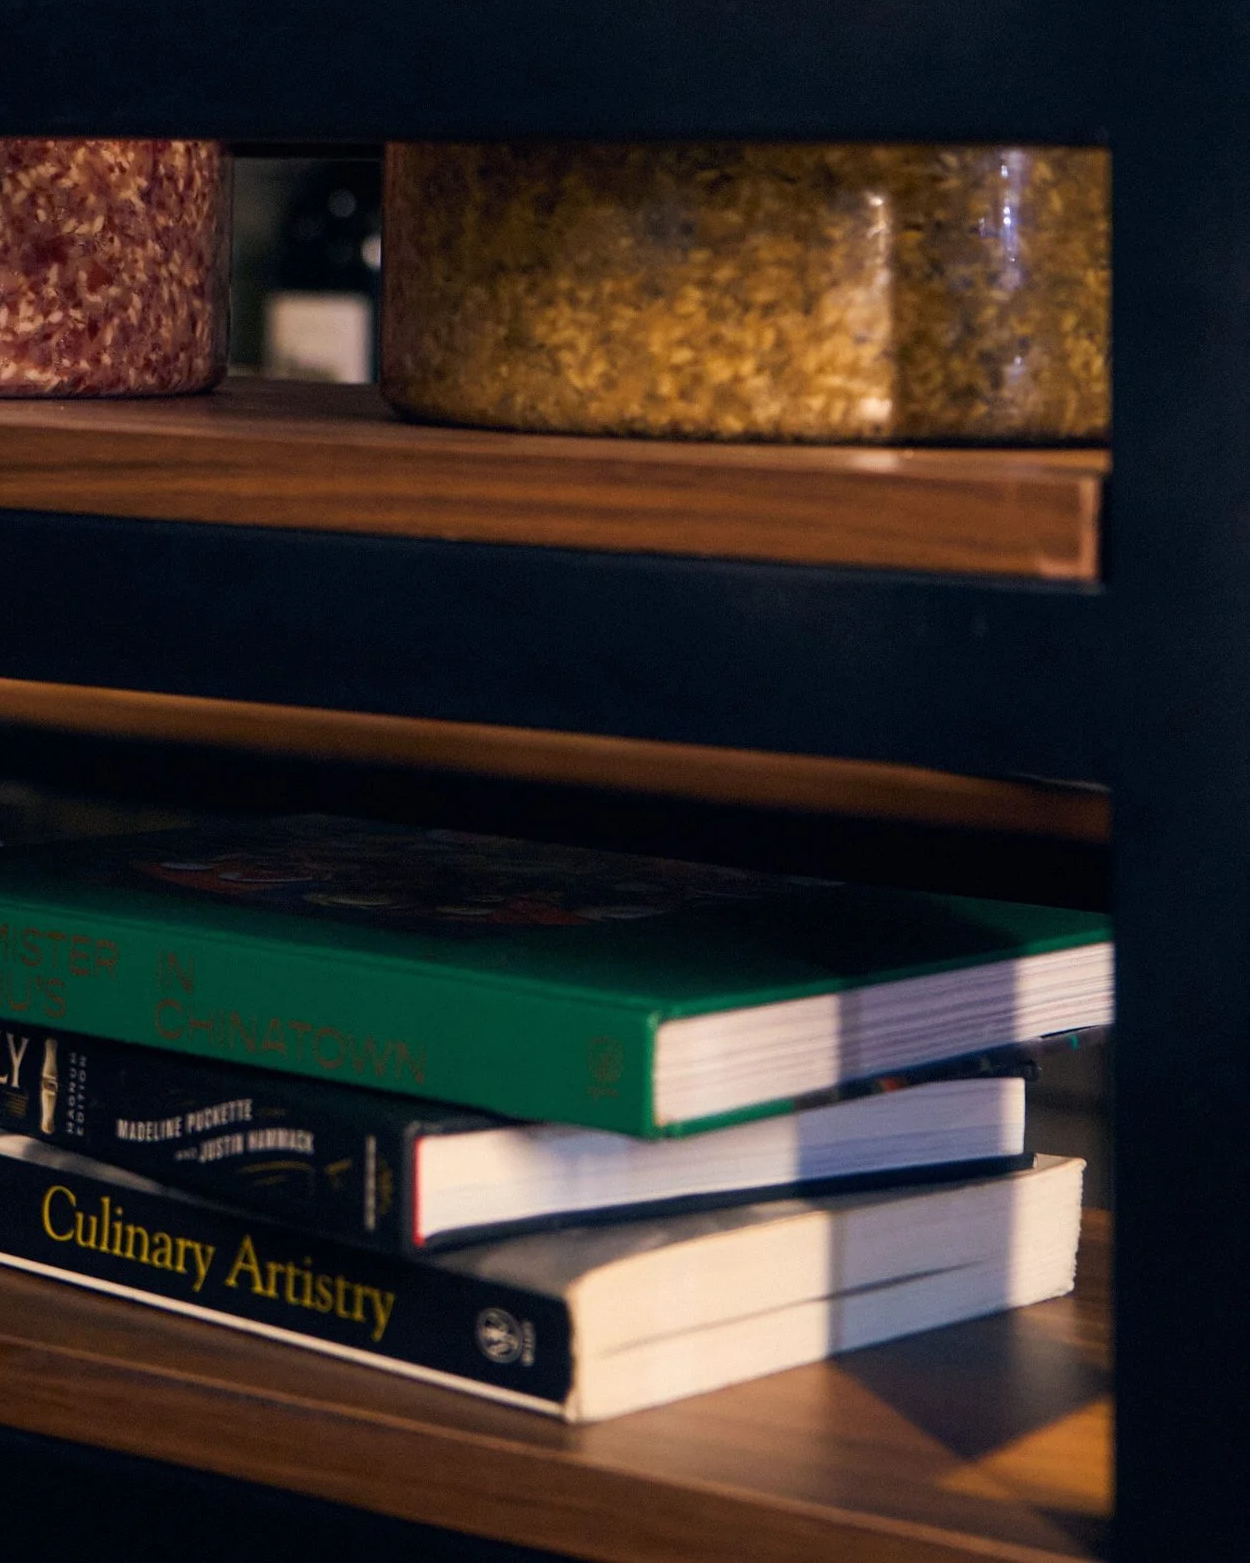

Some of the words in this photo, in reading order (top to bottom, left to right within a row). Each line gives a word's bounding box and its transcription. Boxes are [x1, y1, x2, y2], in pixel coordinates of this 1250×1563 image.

[156, 946, 195, 994] IN
[153, 998, 428, 1086] CHINATOWN
[115, 1116, 182, 1142] MADELINE
[185, 1097, 253, 1134] PUCKETTE
[42, 1183, 215, 1293] Culinary
[226, 1234, 397, 1341] Artistry
